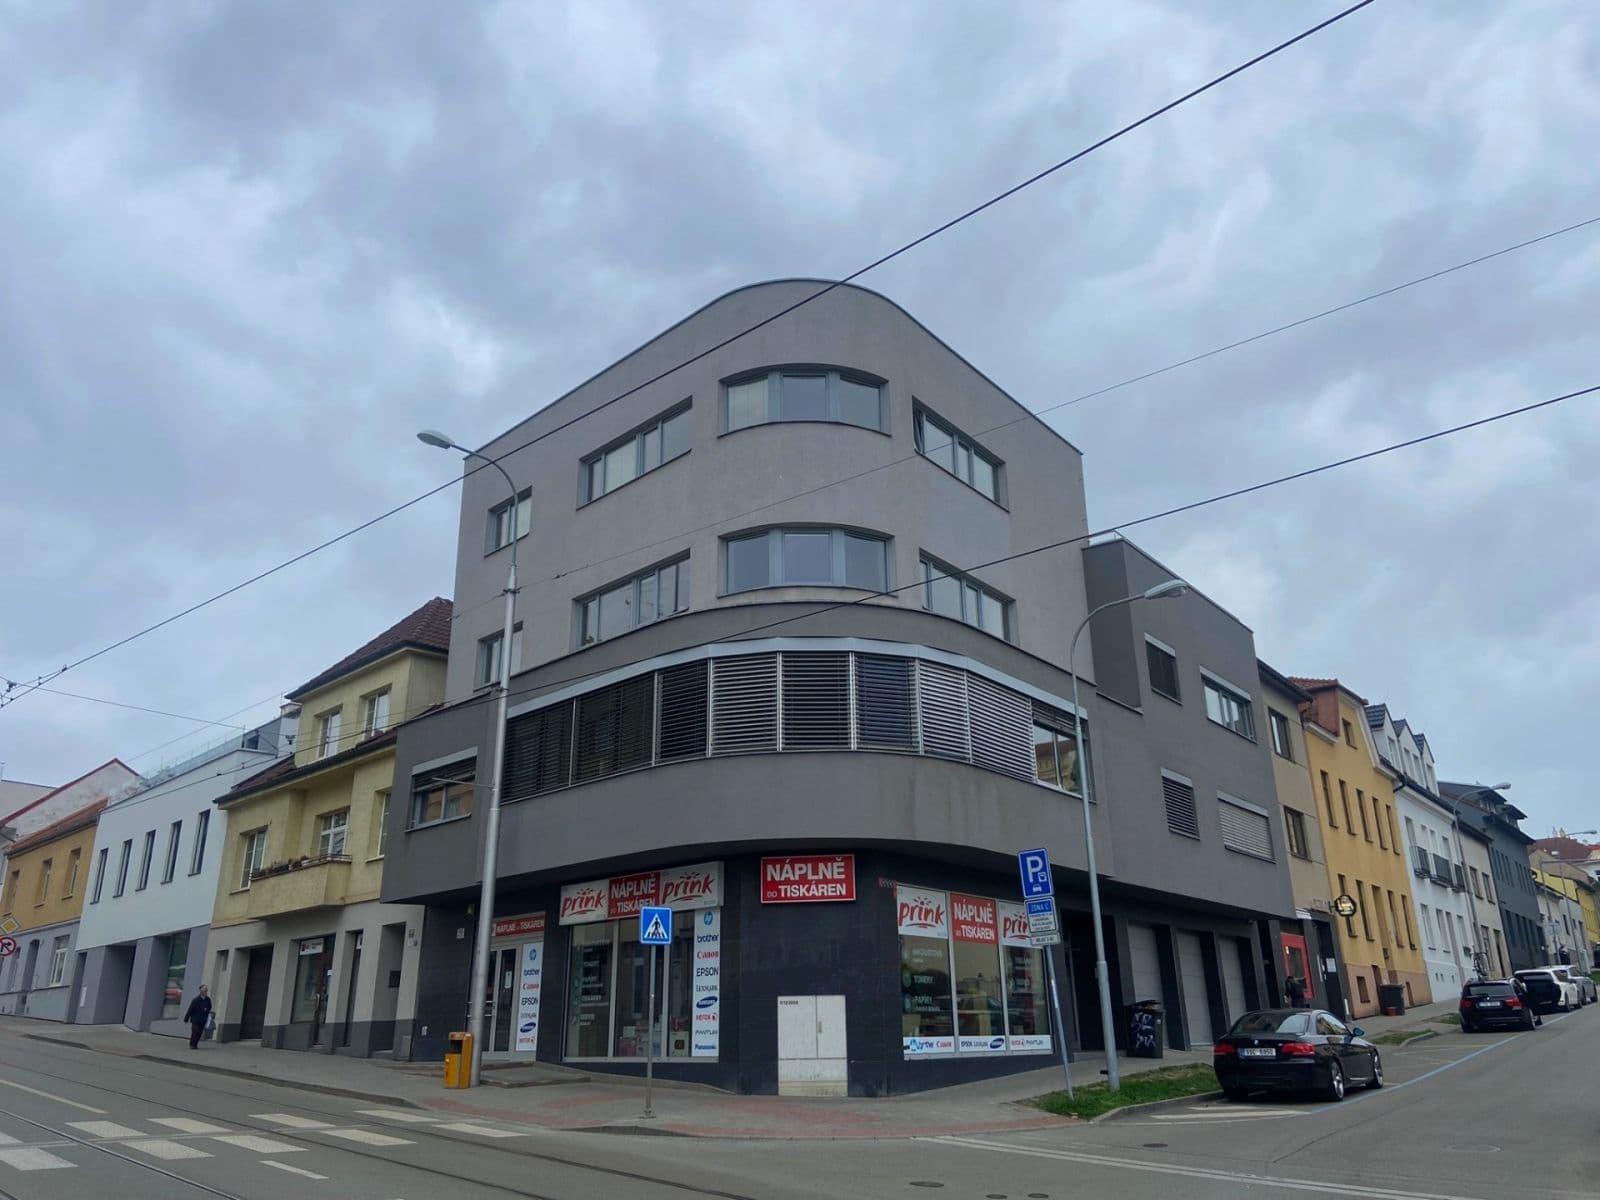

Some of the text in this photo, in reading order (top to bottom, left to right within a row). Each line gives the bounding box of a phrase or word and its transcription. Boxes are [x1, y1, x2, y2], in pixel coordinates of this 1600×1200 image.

[766, 857, 846, 881] NÁPLNĚ
[1026, 856, 1043, 883] P
[611, 874, 656, 899] NÁPLNĚ
[663, 872, 715, 904] prink
[778, 880, 847, 898] TISKÁREN
[561, 889, 606, 917] prink
[898, 901, 945, 927] prink
[953, 899, 993, 924] NÁPLNĚ
[697, 935, 719, 943] brother
[961, 923, 995, 940] TISKÁREN
[696, 951, 720, 959] Canon
[696, 967, 719, 977] EPSON
[521, 997, 538, 1006] EPSON
